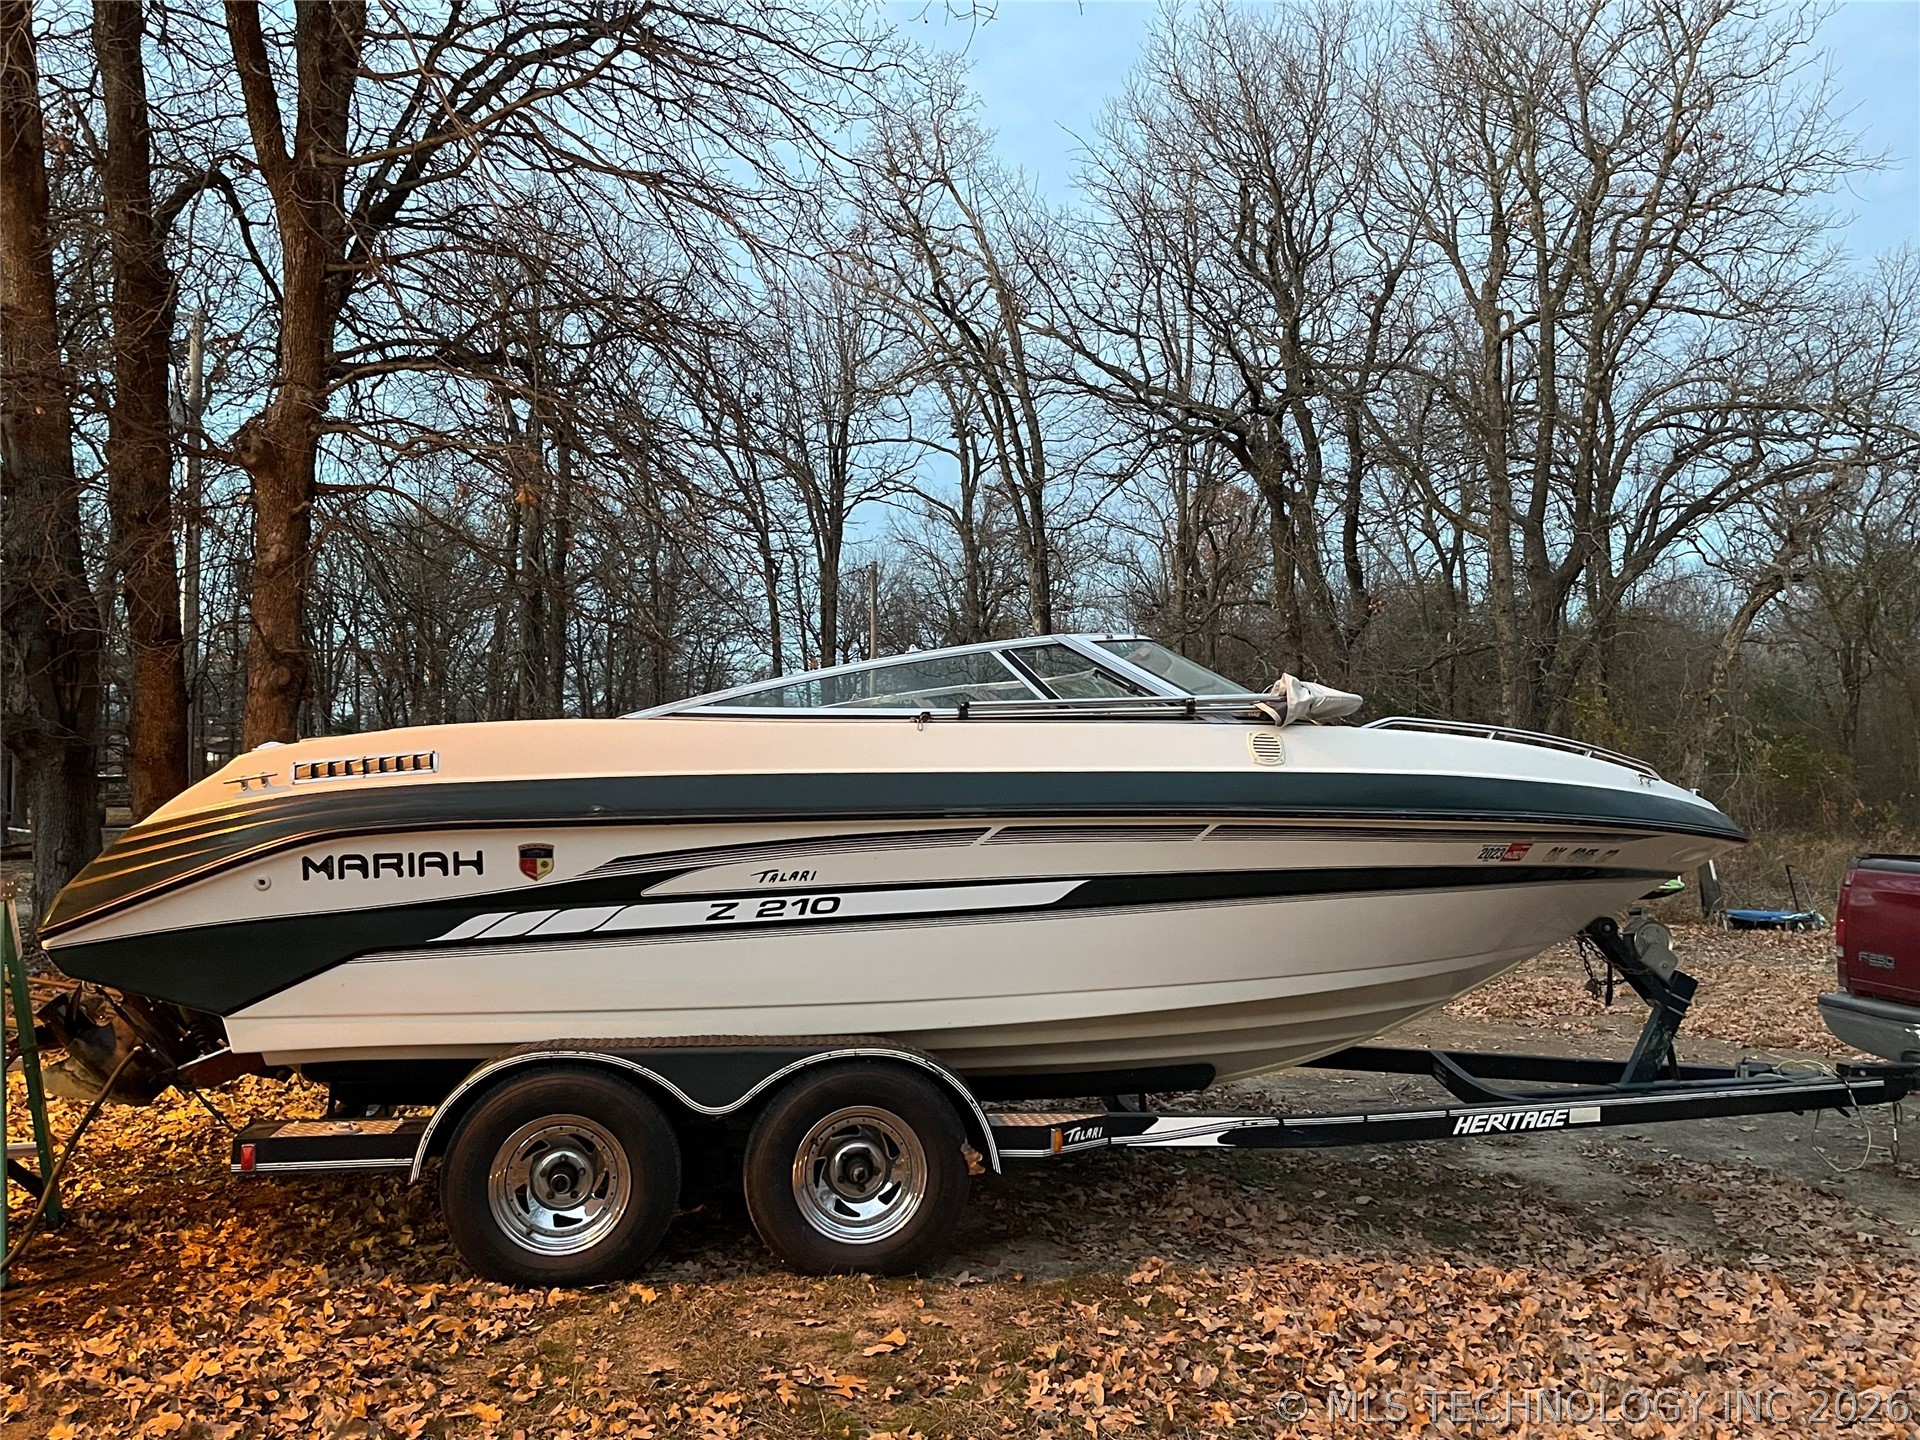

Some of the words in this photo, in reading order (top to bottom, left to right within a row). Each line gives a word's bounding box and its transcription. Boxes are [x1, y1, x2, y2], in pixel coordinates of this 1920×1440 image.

[1477, 847, 1507, 860] 2023
[302, 850, 484, 881] MARIAH
[750, 869, 817, 883] TALARI
[705, 902, 740, 921] Z
[755, 896, 841, 918] 210
[1452, 1108, 1569, 1135] HERITAGE
[1063, 1126, 1103, 1142] TALARI
